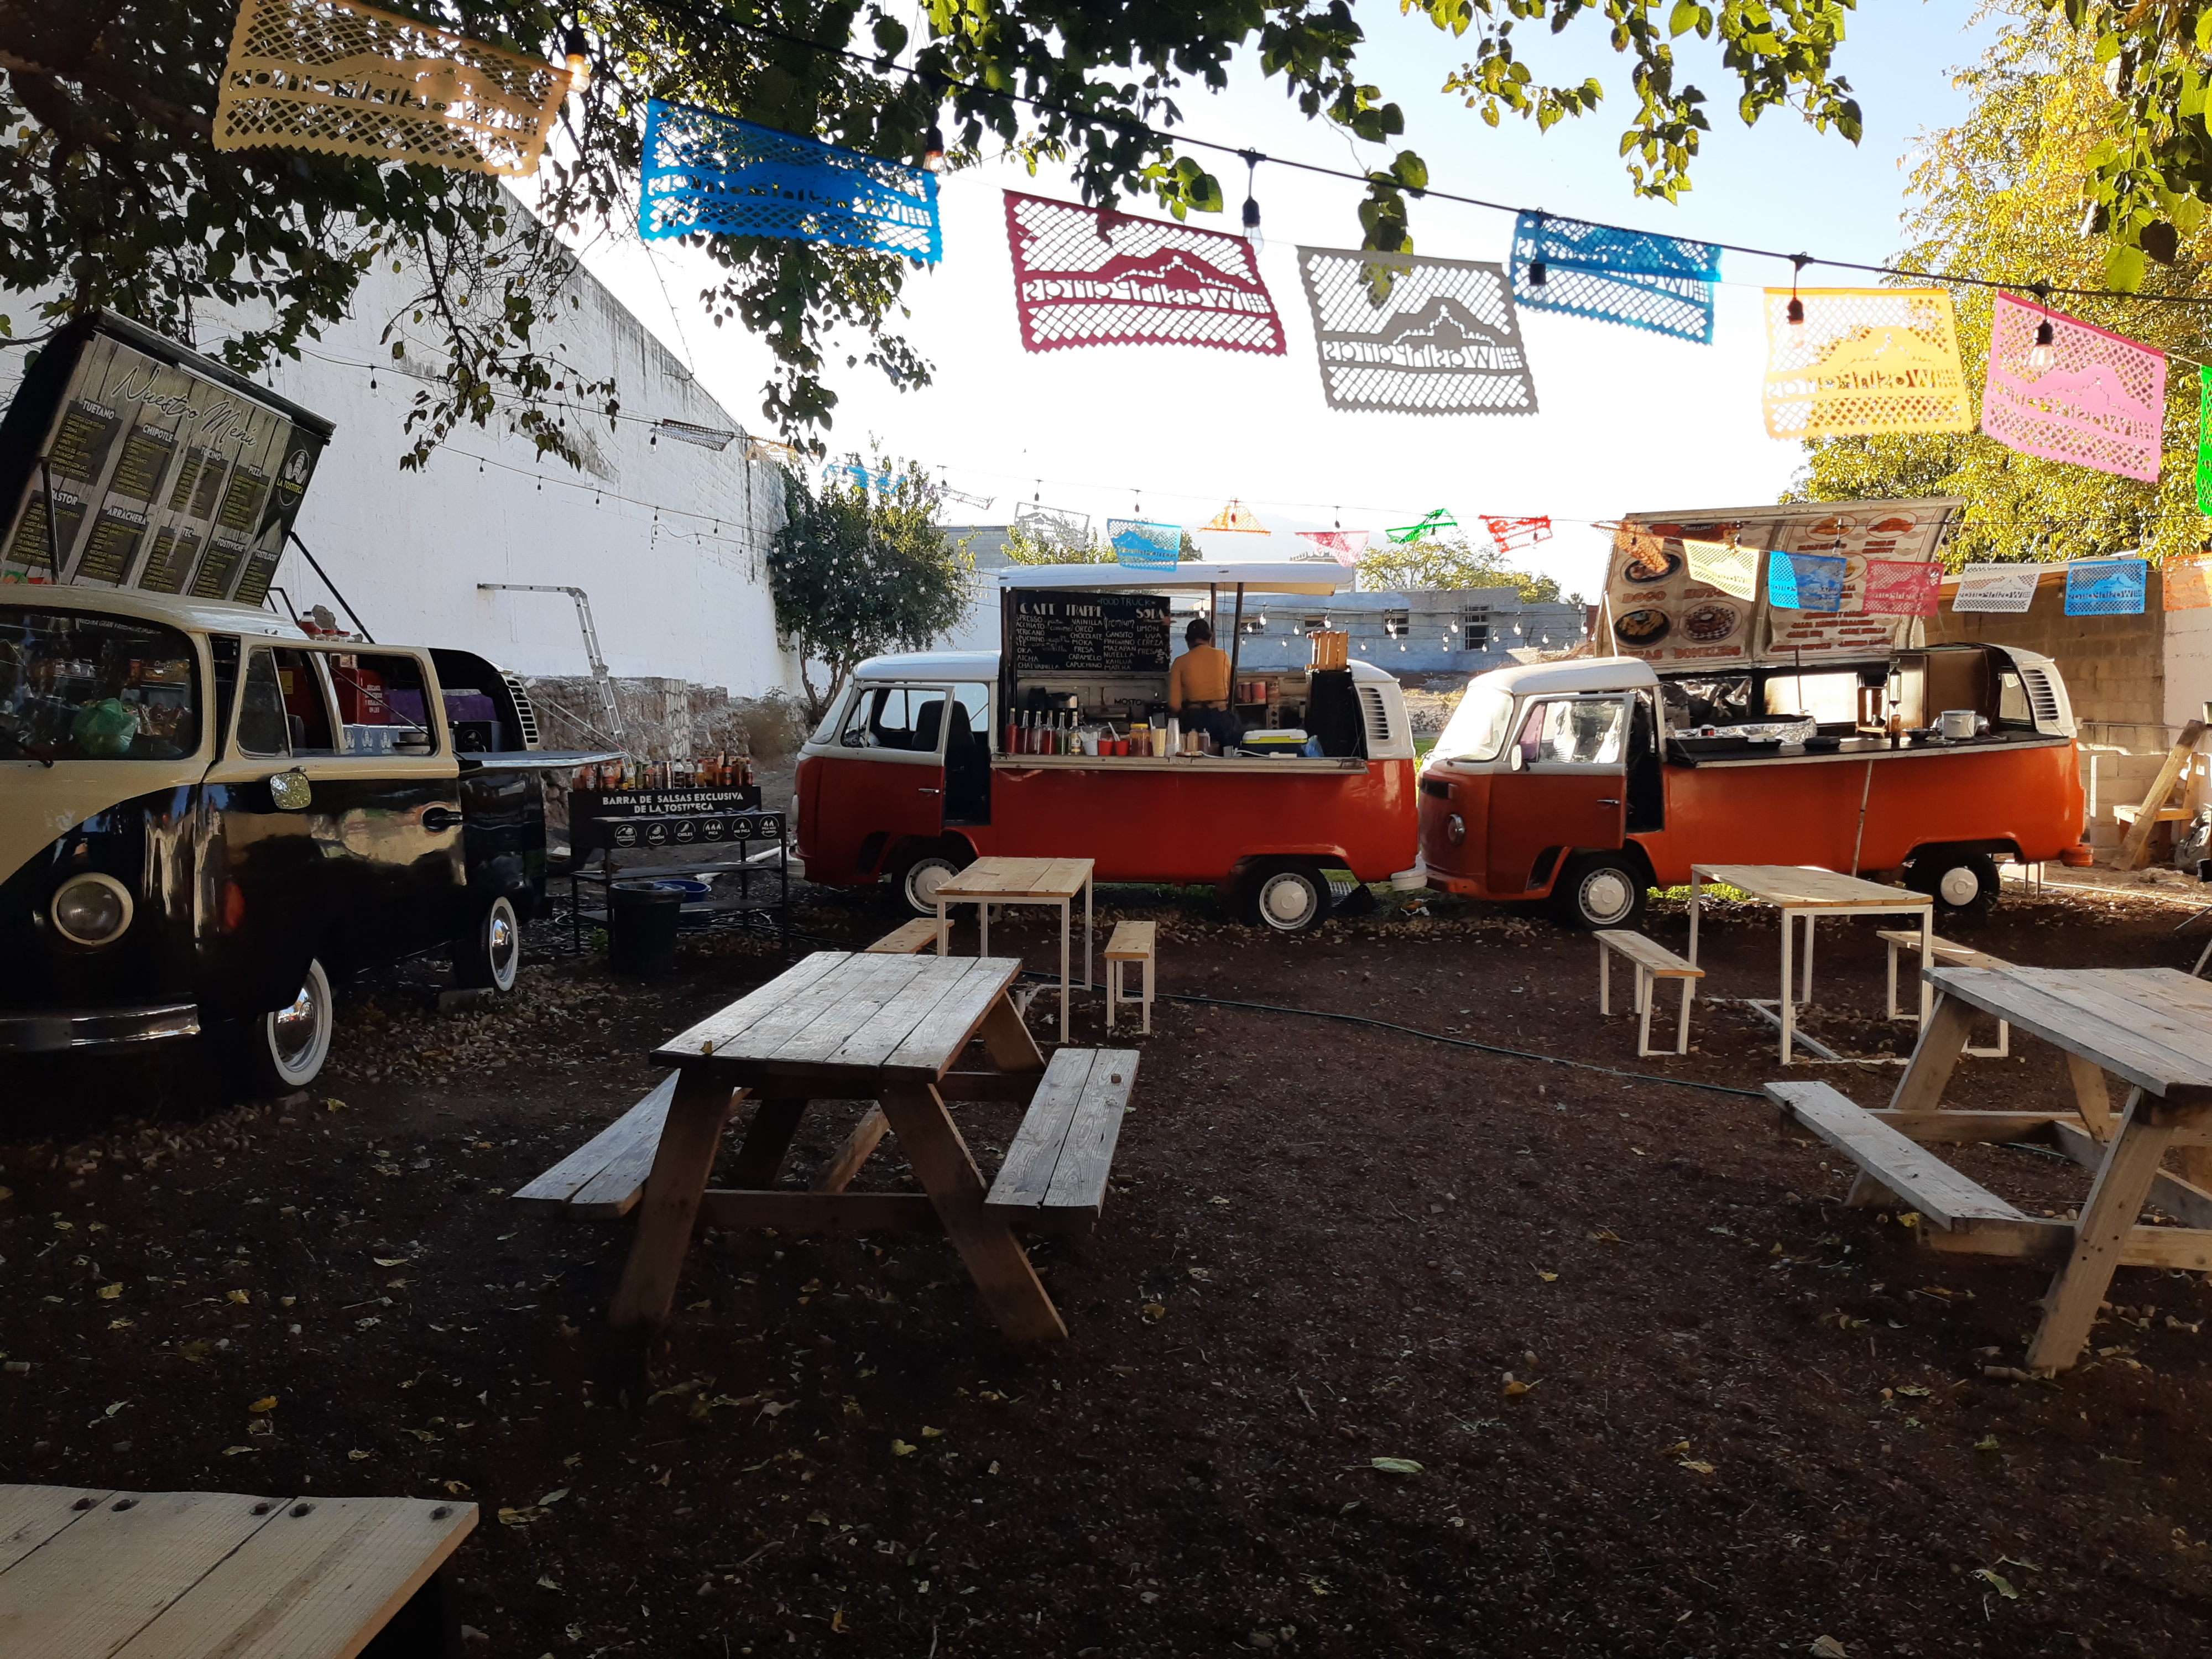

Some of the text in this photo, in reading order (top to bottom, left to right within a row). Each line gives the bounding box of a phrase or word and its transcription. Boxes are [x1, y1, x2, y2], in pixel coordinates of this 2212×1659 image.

[111, 364, 198, 420] Nuestro
[82, 400, 114, 420] TUETANO
[143, 424, 174, 442] CHIPOTLE
[200, 447, 221, 461] TOCINO
[248, 466, 262, 478] PIZZA
[276, 477, 283, 487] LA
[53, 490, 78, 505] ASTOR
[107, 508, 147, 525] ARRACHERA
[1120, 597, 1151, 607] TRUCK
[1621, 590, 1667, 604] DOGO
[1016, 614, 1043, 623] SPRESSO
[1136, 609, 1165, 619] SODA
[1016, 620, 1045, 630] ACCHIATO
[1070, 632, 1103, 641] CHOCOLATE
[1068, 653, 1103, 661] CARAMELO
[603, 792, 743, 805] BARRA DE SALSAS EXCLUSIVA
[634, 803, 714, 813] DE LA TOSTITECA
